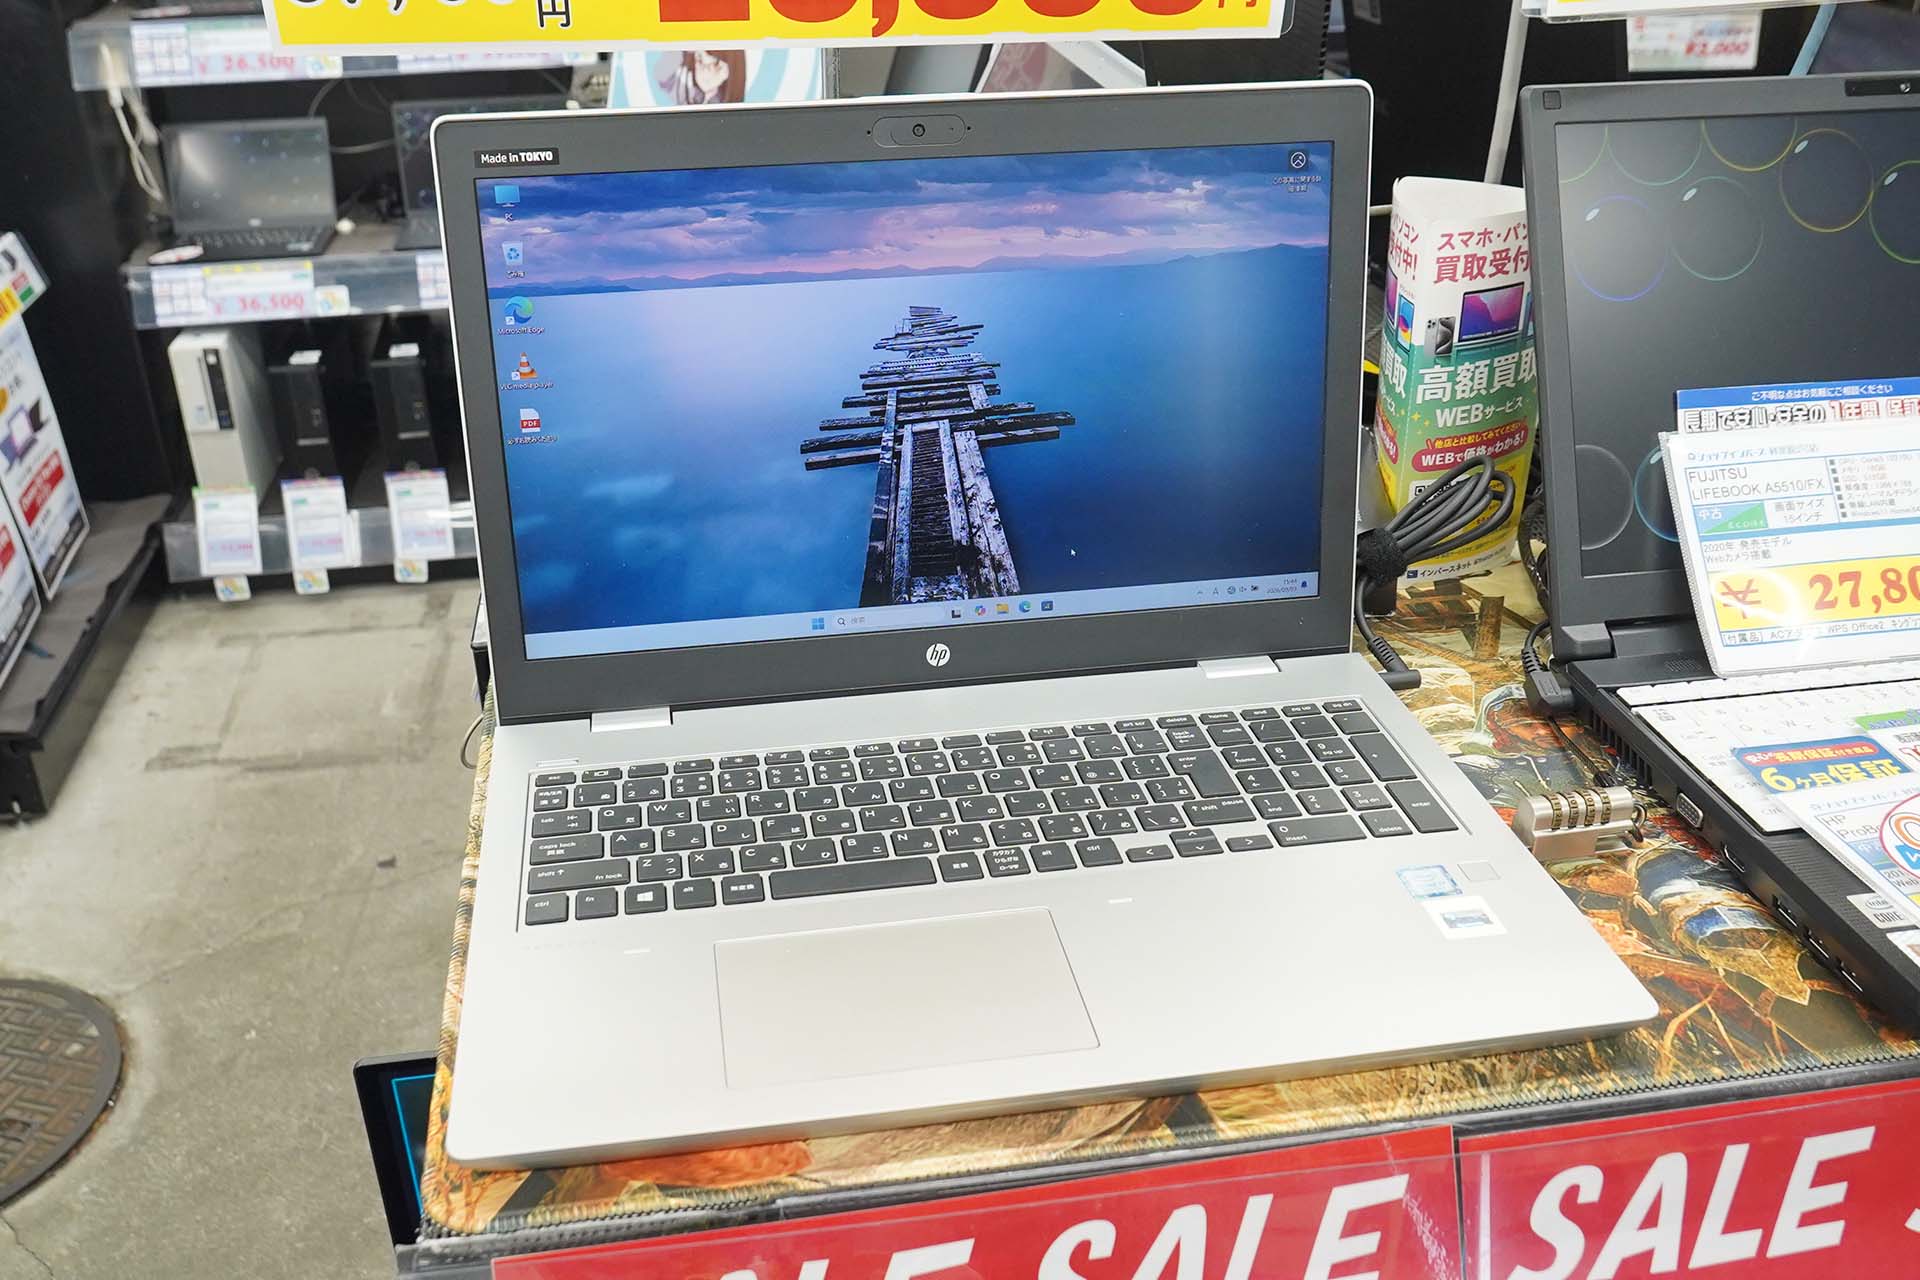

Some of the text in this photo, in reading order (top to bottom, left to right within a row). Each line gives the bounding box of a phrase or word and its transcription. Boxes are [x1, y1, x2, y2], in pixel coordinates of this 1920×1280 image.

[481, 151, 553, 164] Made in TOKYO
[498, 328, 527, 337] Microsoft
[1416, 348, 1536, 404] 高額買取
[1436, 396, 1524, 428] WEBサービス
[1688, 467, 1748, 483] FUJITSU
[1692, 484, 1761, 501] LIFEBOOK
[1765, 478, 1825, 493] A5510/FX
[1775, 498, 1825, 512] 画面サイズ
[1698, 508, 1723, 520] 中古
[1703, 542, 1734, 553] 2020年
[1420, 561, 1471, 578] インバースネット
[1720, 578, 1761, 620] ¥
[1828, 624, 1849, 633] WPS
[928, 643, 949, 667] hp
[654, 804, 668, 812] W
[1822, 814, 1847, 826] HP
[643, 859, 652, 867] Z
[695, 854, 704, 862] X
[1504, 1126, 1876, 1280] SALE
